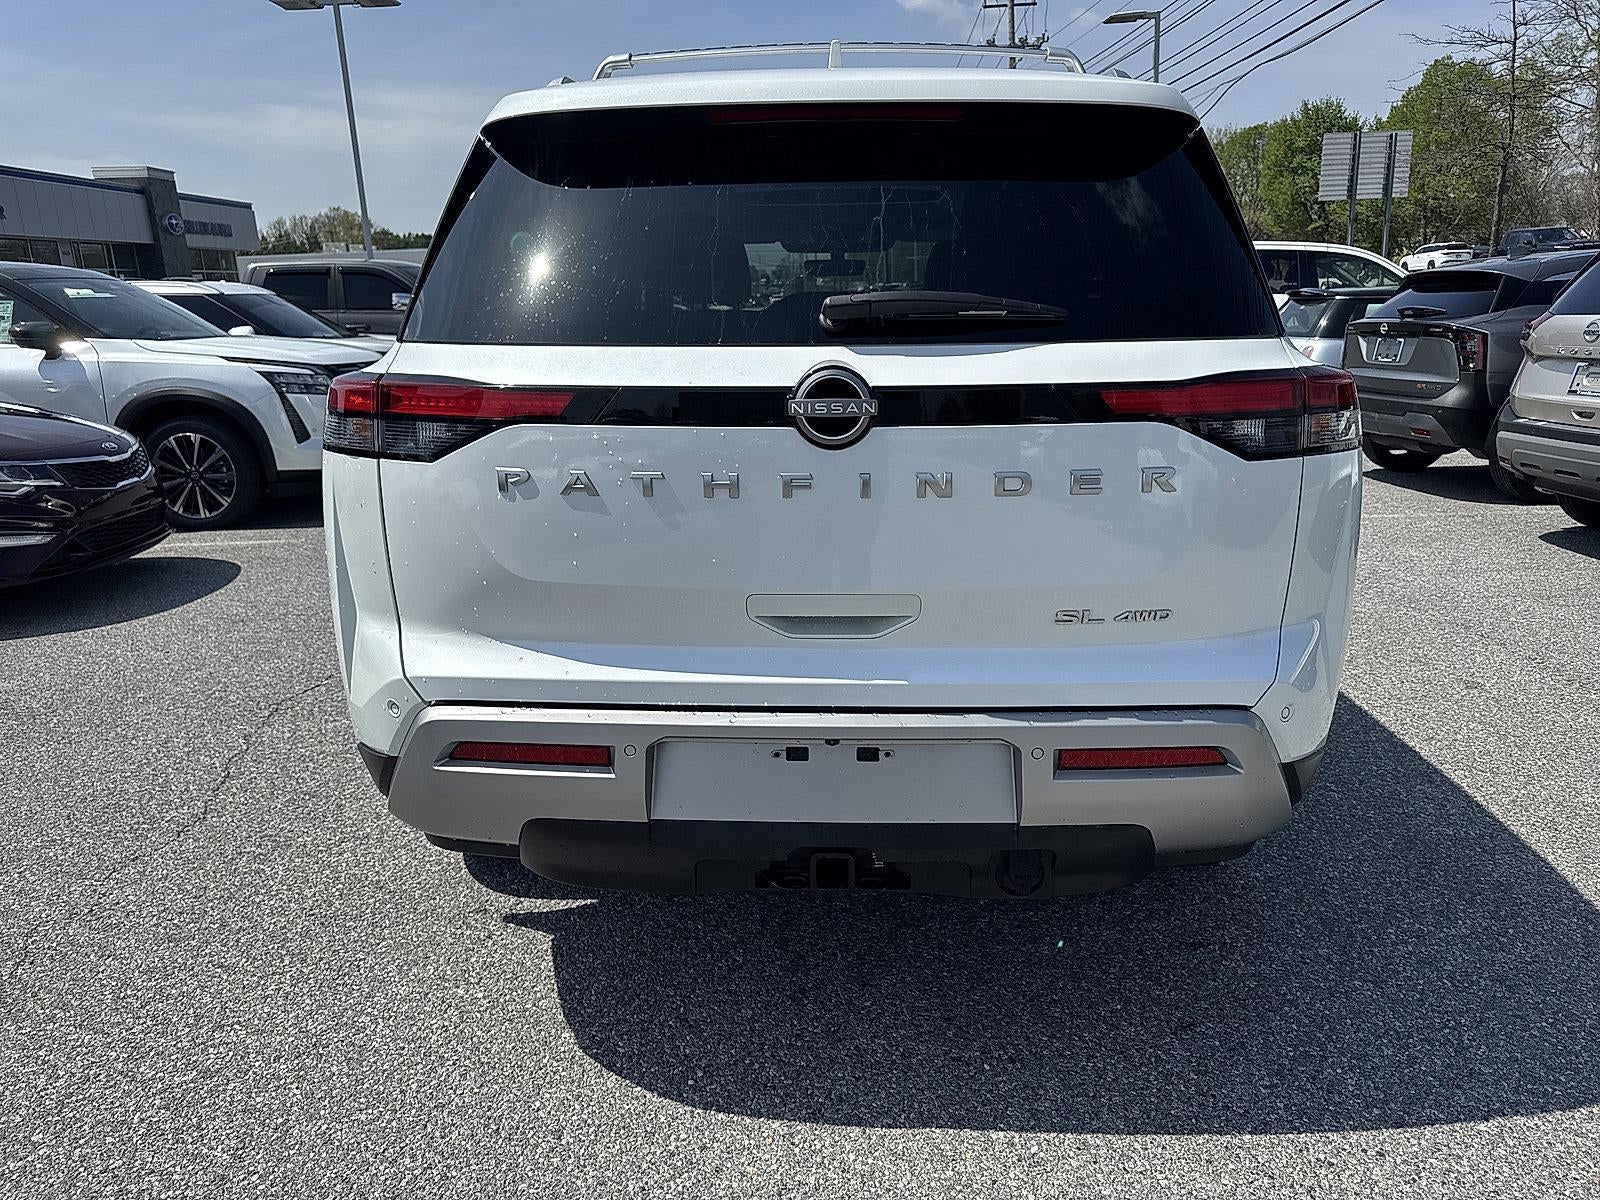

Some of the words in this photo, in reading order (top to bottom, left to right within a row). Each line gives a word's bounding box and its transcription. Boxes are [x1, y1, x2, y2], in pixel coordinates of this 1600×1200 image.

[791, 402, 875, 414] NISSAN
[494, 466, 1177, 499] PATHFINDER
[1054, 609, 1106, 625] SL
[1113, 609, 1173, 623] 4WD
